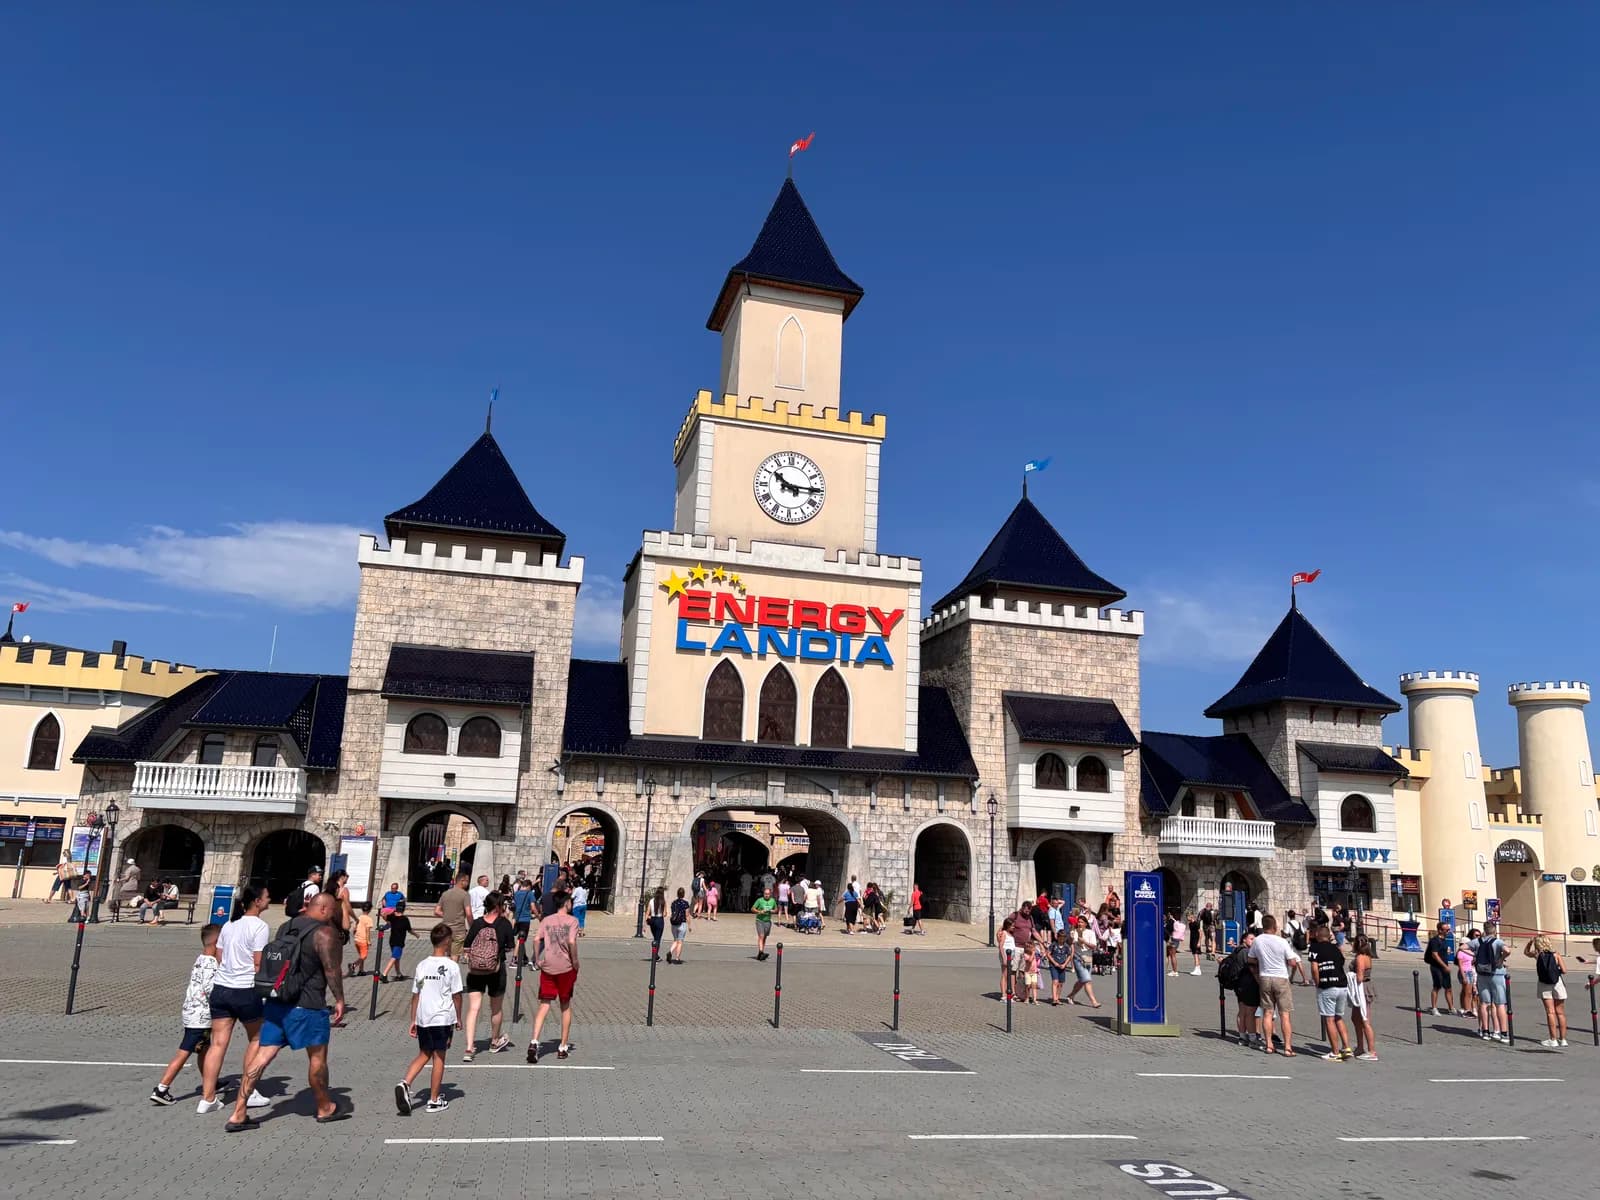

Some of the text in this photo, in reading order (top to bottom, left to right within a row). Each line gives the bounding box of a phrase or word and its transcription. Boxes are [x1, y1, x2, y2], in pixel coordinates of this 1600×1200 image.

[677, 588, 905, 637] ENERGY
[675, 619, 894, 666] LANDIA
[1331, 845, 1391, 863] GRUPY
[872, 1042, 943, 1061] TAXI
[1119, 1163, 1249, 1200] US
